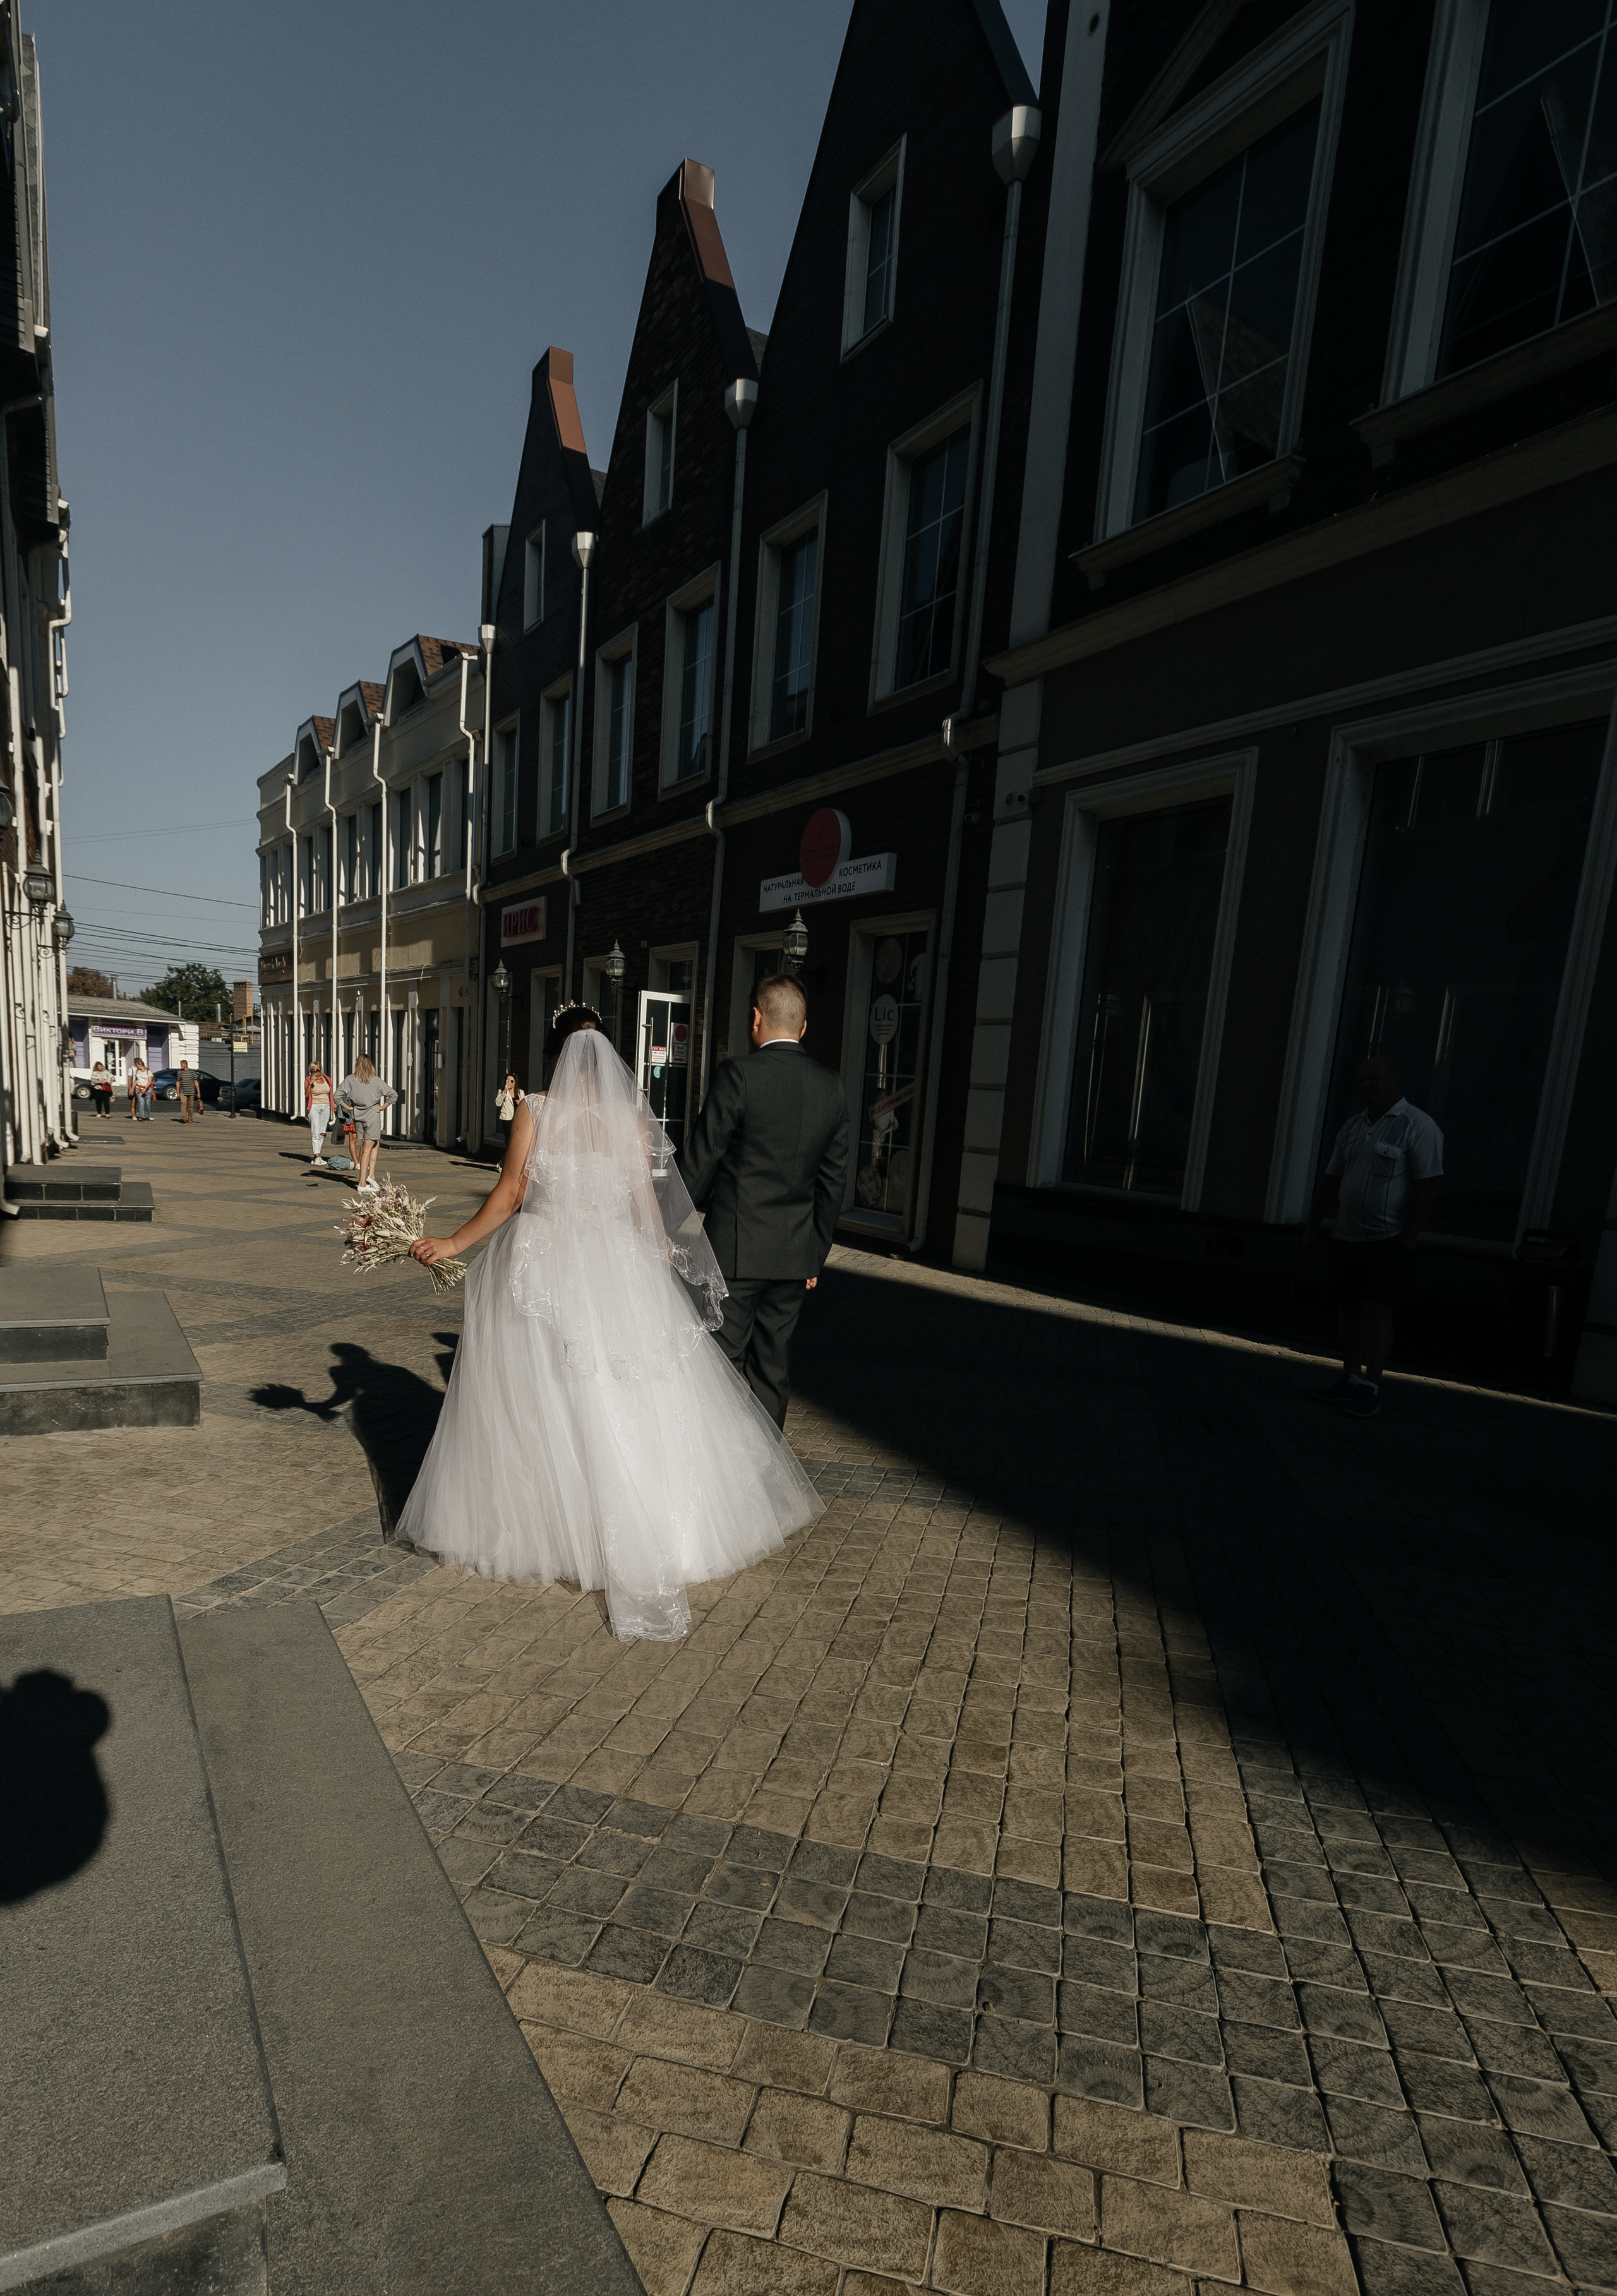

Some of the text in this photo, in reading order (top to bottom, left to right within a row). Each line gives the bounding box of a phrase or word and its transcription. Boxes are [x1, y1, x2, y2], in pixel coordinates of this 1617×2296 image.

[763, 860, 881, 894] НАТУРАЛЬНАЯ КОСМЕТИКА
[783, 882, 856, 903] НА ТЕРМАЛЬНОЙ ВОДЕ
[874, 1007, 894, 1021] Lic
[870, 1087, 914, 1117] ПОДАРОЧНЫЕ НАБ
